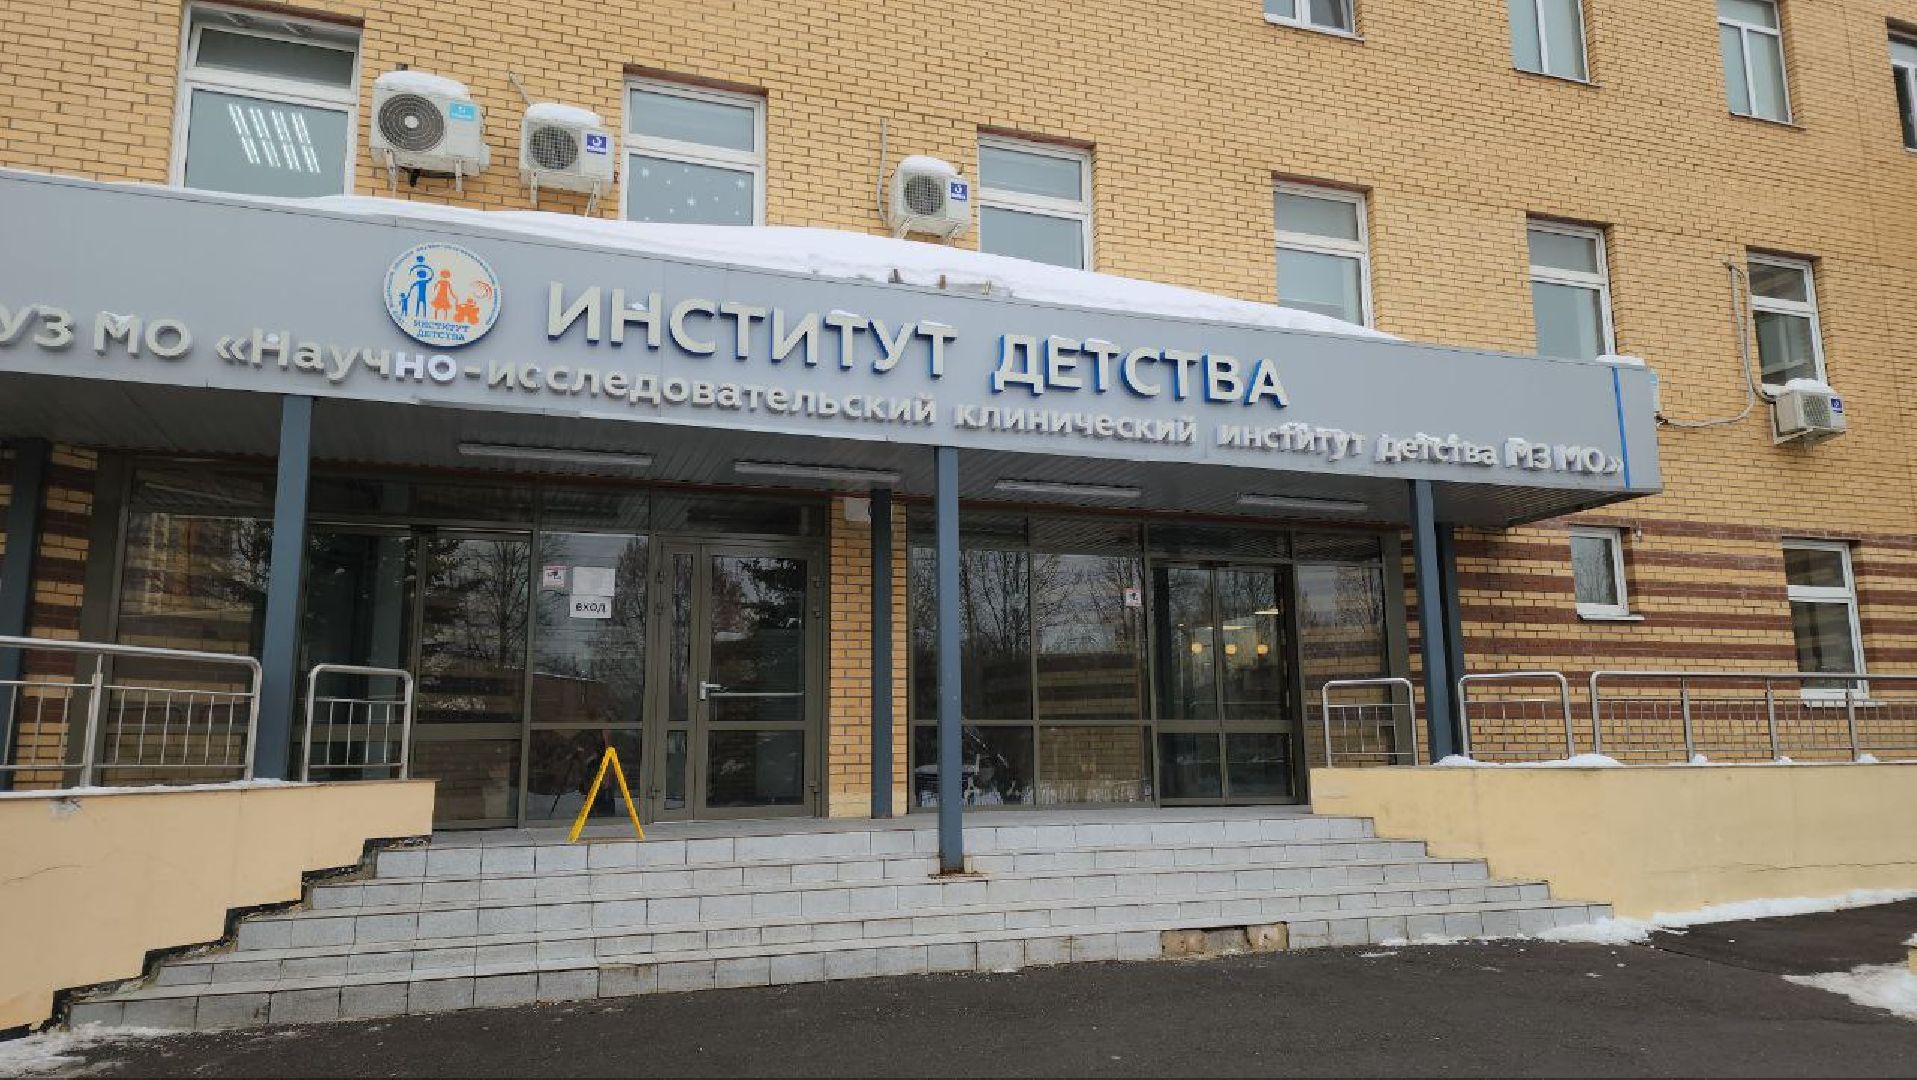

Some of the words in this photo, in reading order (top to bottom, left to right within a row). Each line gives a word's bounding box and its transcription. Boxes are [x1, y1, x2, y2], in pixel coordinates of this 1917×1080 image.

[93, 311, 193, 358] МО
[954, 404, 1198, 445] клинический
[1216, 423, 1365, 461] институт
[1376, 433, 1498, 466] детства
[1505, 438, 1551, 470] МЗ
[1554, 444, 1624, 474] МО»
[547, 281, 957, 378] ИНСТИТУТ
[991, 333, 1289, 408] ДЕТСТВА
